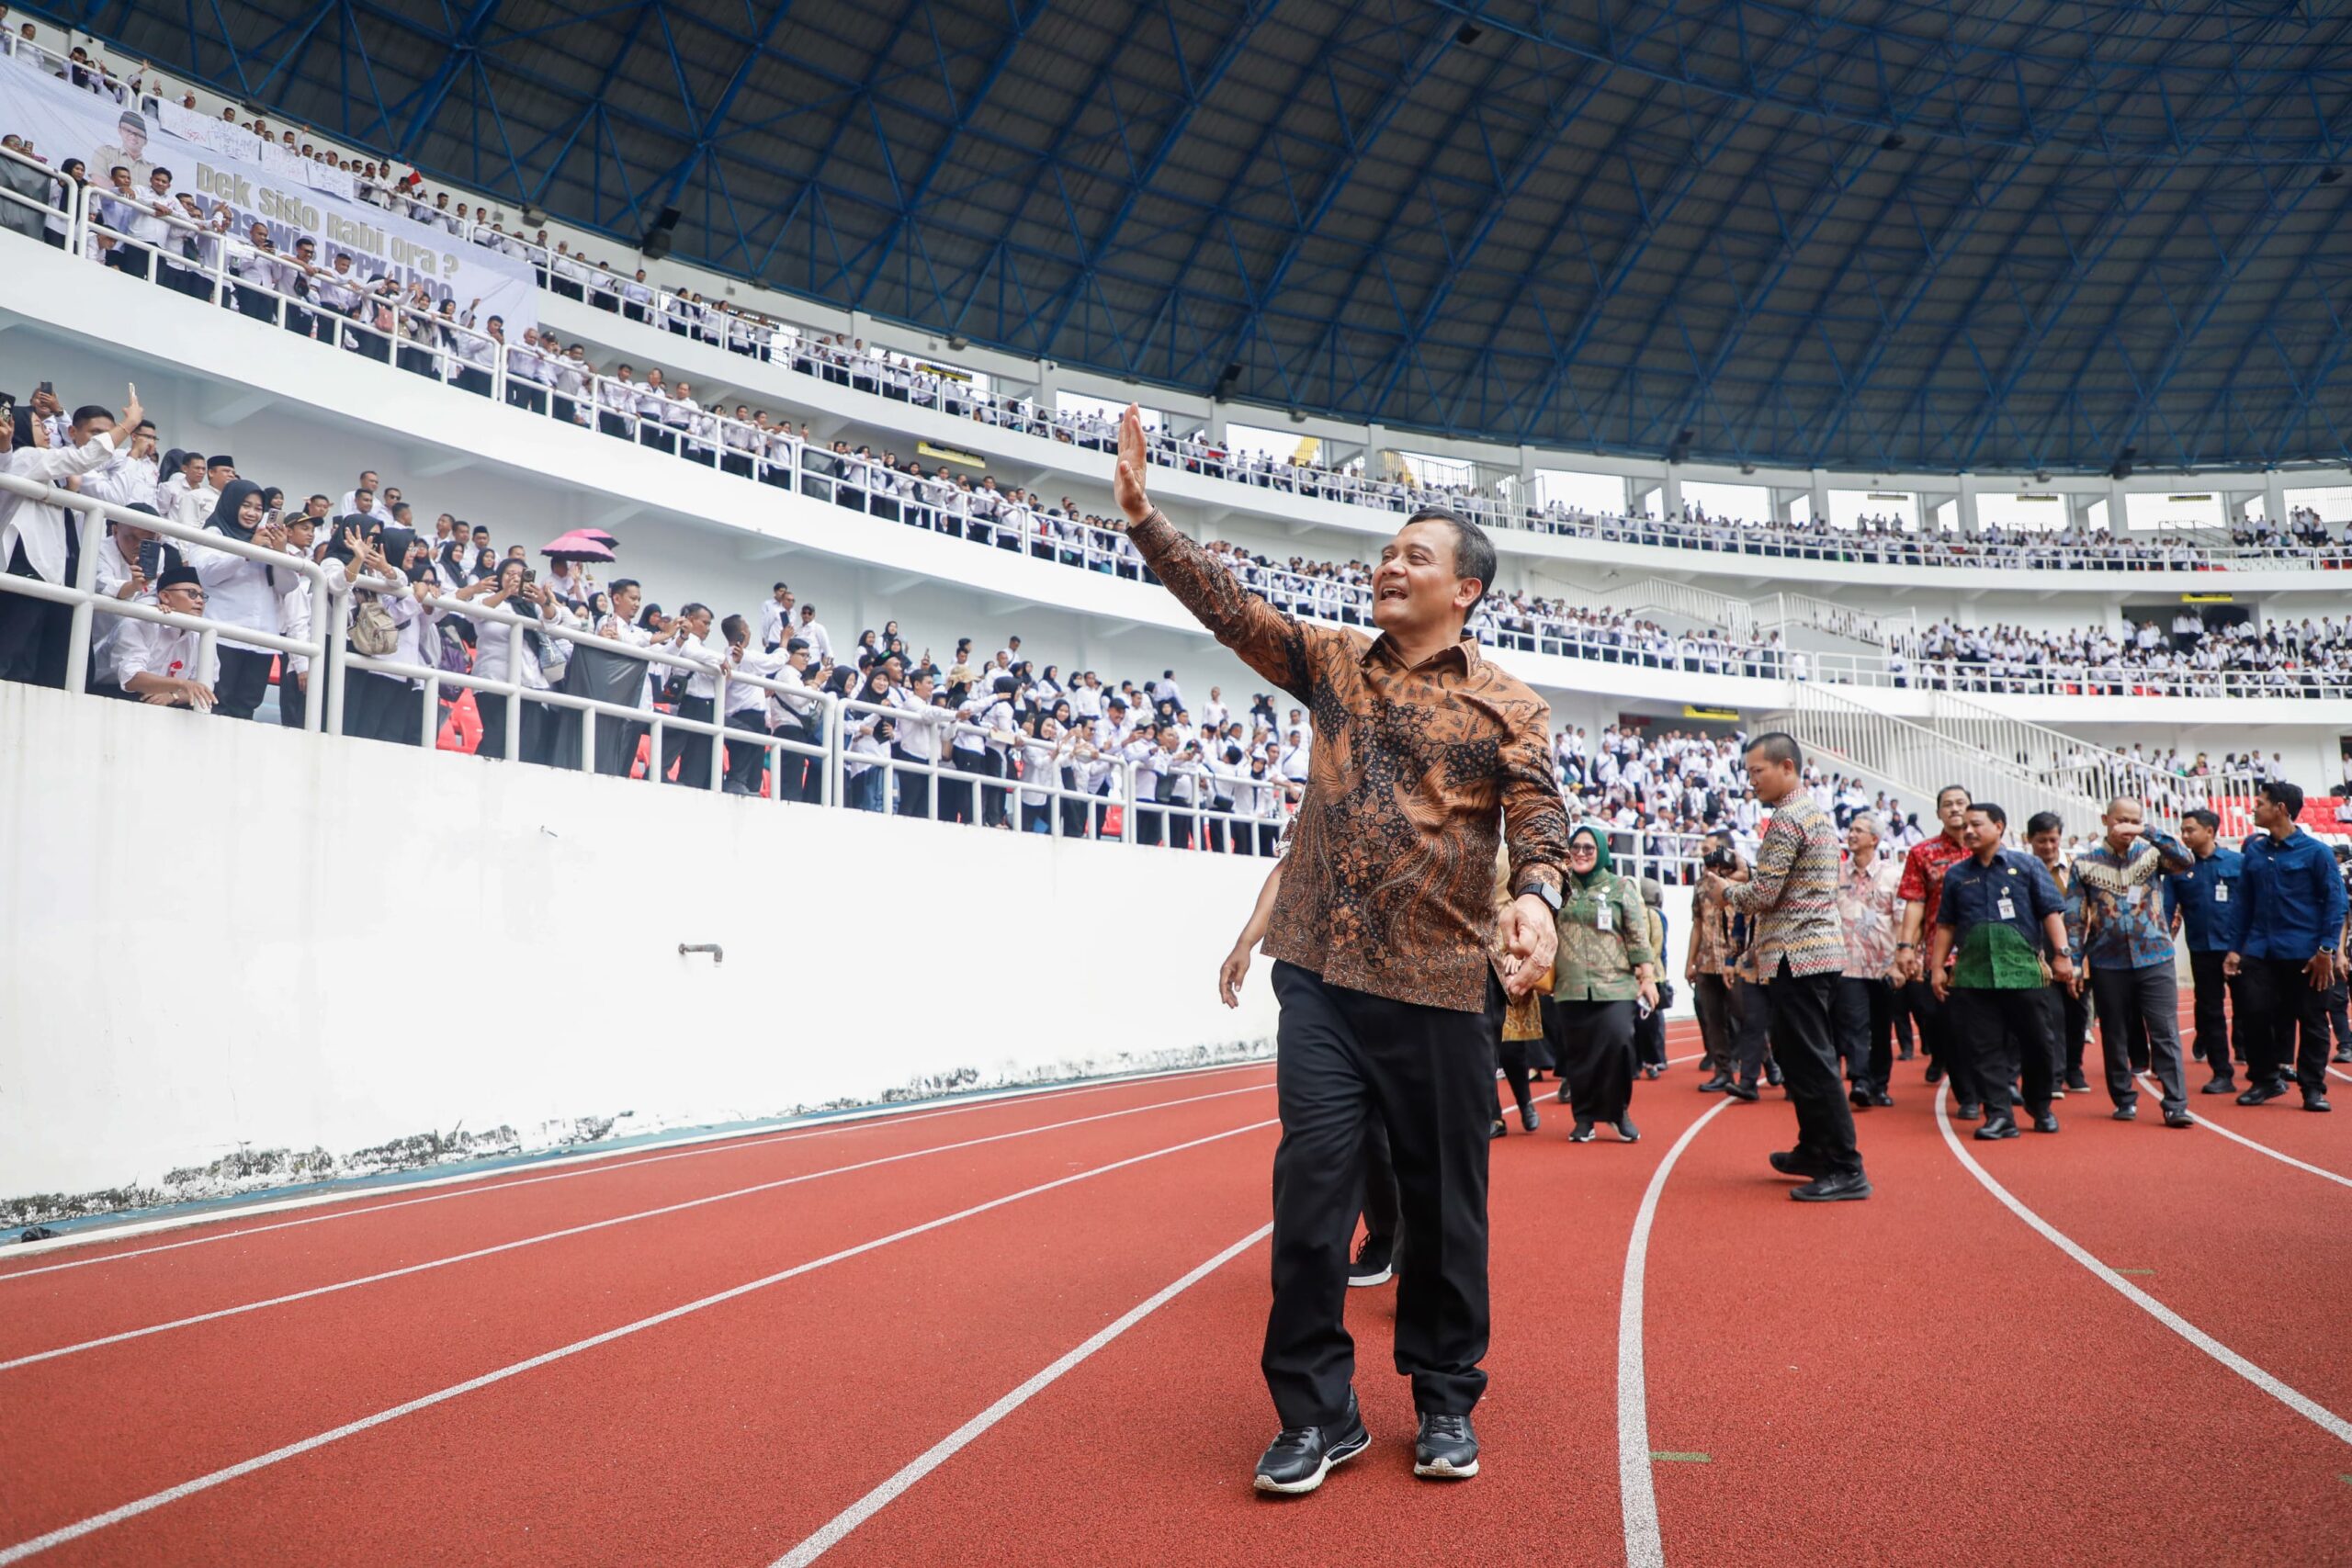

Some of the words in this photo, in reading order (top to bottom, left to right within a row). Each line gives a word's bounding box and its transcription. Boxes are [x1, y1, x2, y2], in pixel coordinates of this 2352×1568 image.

[197, 162, 252, 209] Dek
[258, 186, 320, 232] Sido
[327, 211, 384, 256] Rabi
[390, 235, 436, 275] Ora
[442, 253, 458, 279] ?
